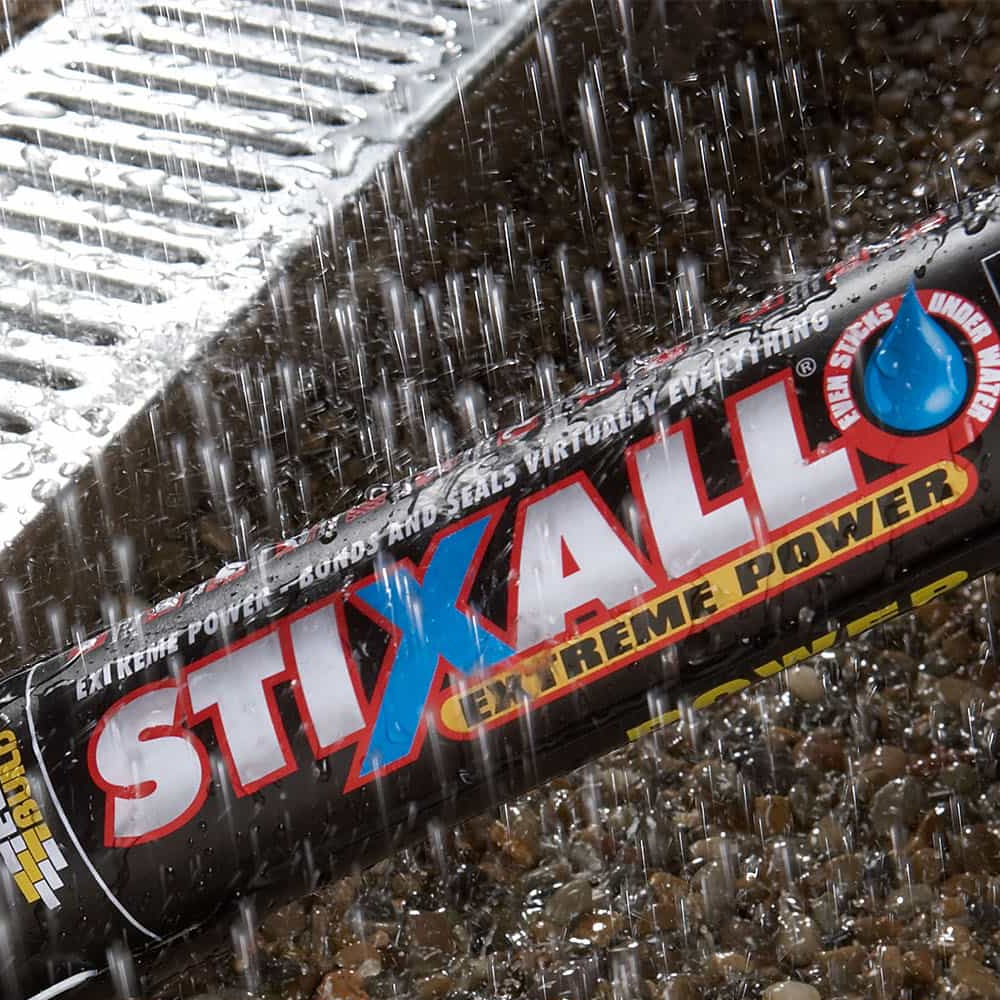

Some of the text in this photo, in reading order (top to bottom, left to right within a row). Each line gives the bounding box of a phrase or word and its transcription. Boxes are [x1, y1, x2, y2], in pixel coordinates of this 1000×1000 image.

[76, 635, 179, 700] EXTREME
[300, 532, 381, 585] BONDS
[388, 504, 437, 545] AND
[446, 463, 517, 511] SEALS
[524, 391, 658, 474] VIRTUALLY
[668, 309, 830, 405] EVERYTHING
[827, 291, 1000, 431] EVEN STICKS UNDER WATER
[94, 372, 864, 844] STIXALL
[461, 580, 717, 729] EXTREME
[735, 468, 954, 596] POWER
